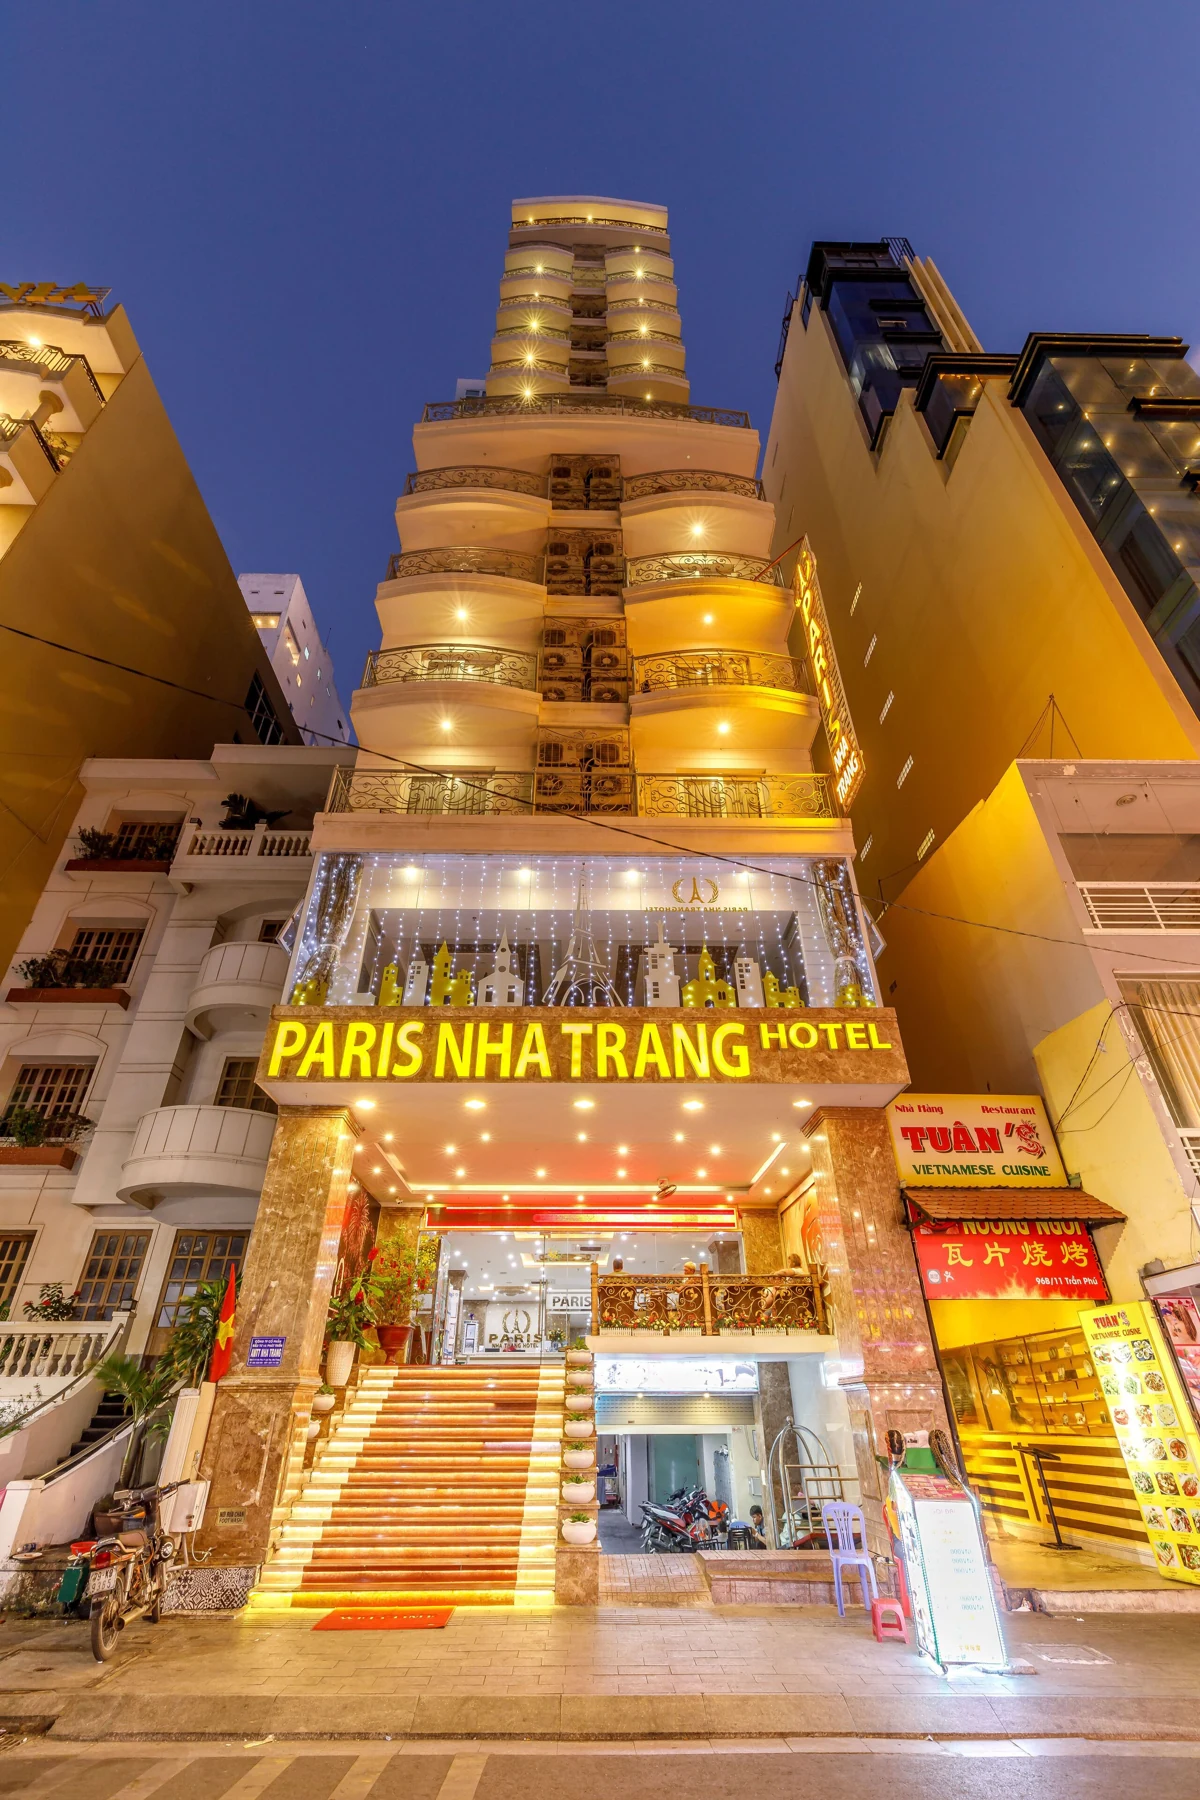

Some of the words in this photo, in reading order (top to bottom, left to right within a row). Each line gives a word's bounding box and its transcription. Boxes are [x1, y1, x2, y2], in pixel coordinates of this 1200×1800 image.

[801, 588, 842, 744] PARIS
[834, 735, 849, 774] NHA
[836, 750, 859, 804] TRANG
[267, 1021, 425, 1078] PARIS
[434, 1022, 552, 1078] NHA
[561, 1022, 751, 1078] TRANG
[759, 1023, 892, 1050] HOTEL
[894, 1104, 914, 1113] Nhà
[917, 1104, 944, 1115] Hàng
[981, 1105, 1036, 1115] Restaurant
[912, 1164, 996, 1175] VIETNAMESE
[1001, 1164, 1051, 1177] CUISINE
[942, 1240, 1089, 1267] 瓦片烧烤
[1083, 1277, 1098, 1285] Phú
[552, 1296, 591, 1307] PARIS
[488, 1333, 542, 1344] PARIS
[1091, 1330, 1121, 1340] VIETNAMESE
[1122, 1327, 1142, 1337] CUISINE
